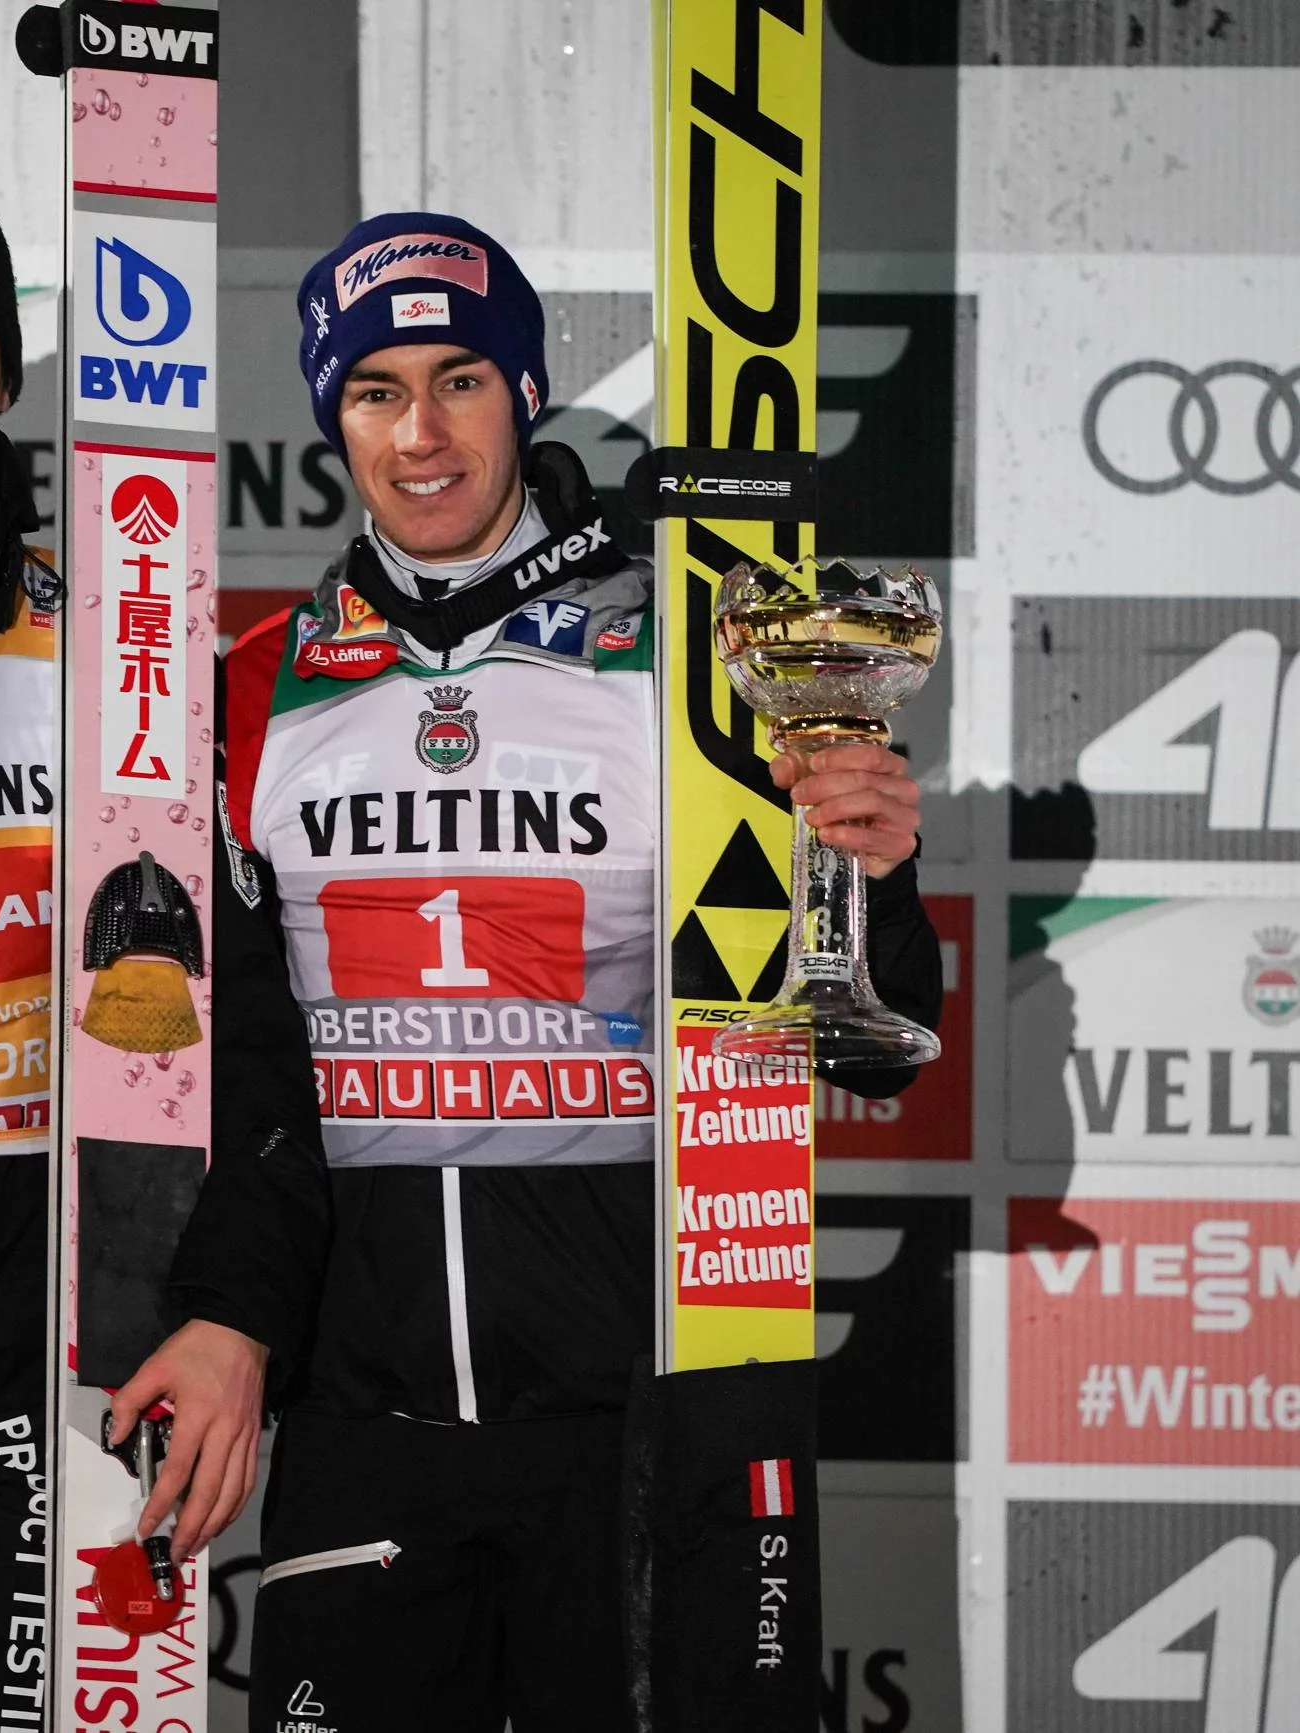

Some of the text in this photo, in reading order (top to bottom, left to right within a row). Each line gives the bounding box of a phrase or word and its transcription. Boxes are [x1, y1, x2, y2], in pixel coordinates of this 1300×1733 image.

[121, 25, 214, 65] BWT
[343, 240, 478, 296] Manner
[80, 355, 207, 409] BWT
[514, 517, 612, 590] uvex
[116, 553, 173, 781] 土屋ホーム
[329, 647, 383, 662] Löffler
[300, 789, 608, 857] VELTINS
[417, 889, 489, 987] 1
[677, 1045, 809, 1093] Kronen
[677, 1097, 811, 1148] Zeitung
[677, 1185, 810, 1233] Kronen
[677, 1237, 812, 1288] Zeitung
[755, 1534, 789, 1670] S. Kraft
